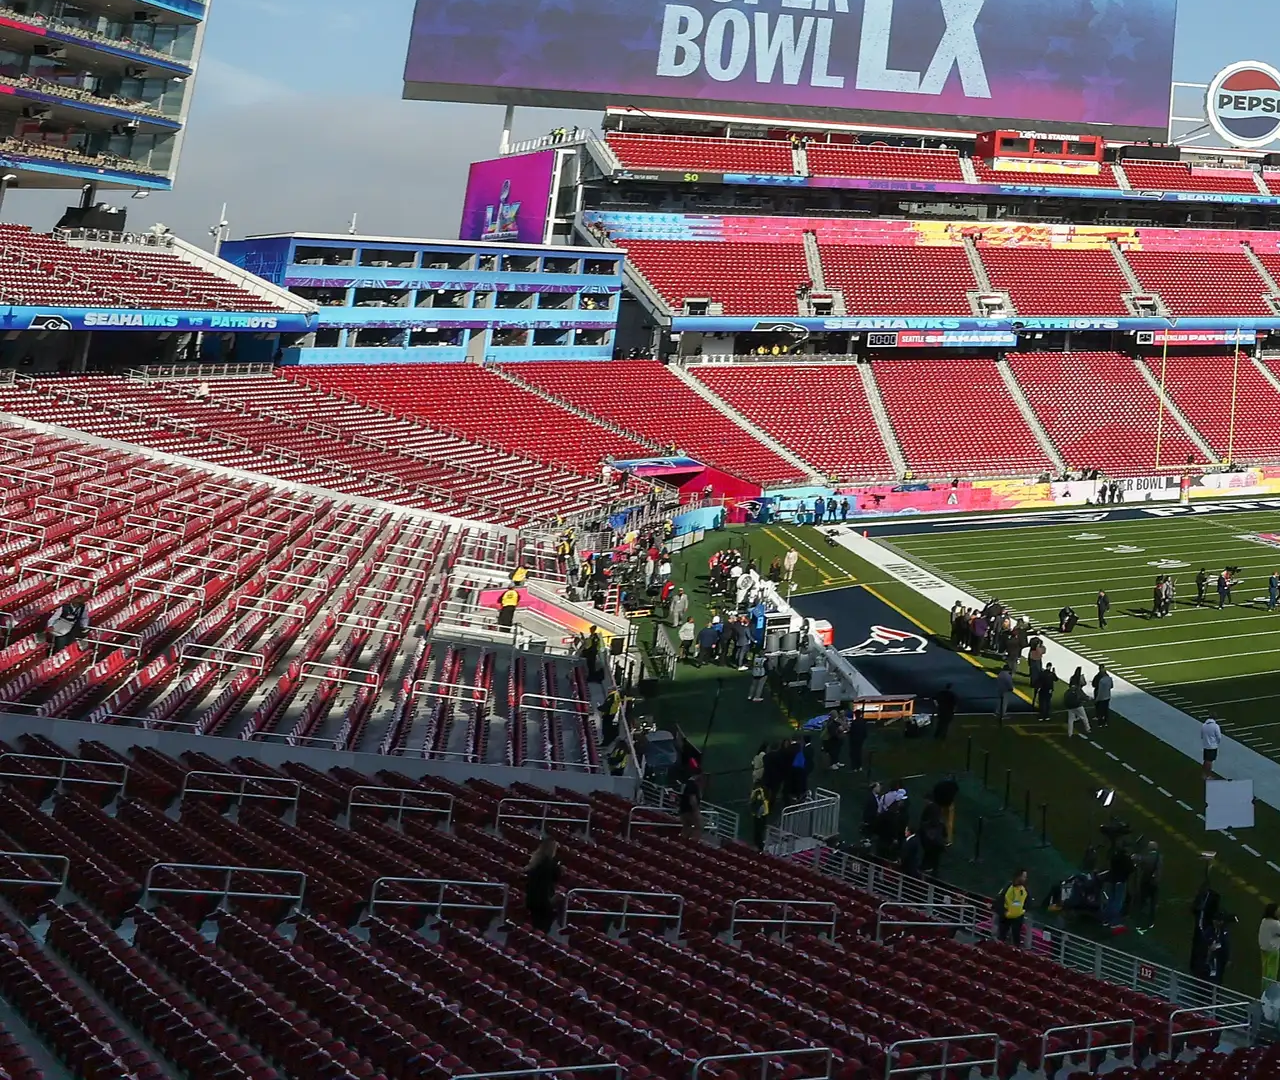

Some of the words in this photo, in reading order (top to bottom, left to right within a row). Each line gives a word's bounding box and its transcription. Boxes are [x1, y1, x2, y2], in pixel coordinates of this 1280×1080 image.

[656, 4, 845, 89] BOWL
[1047, 133, 1080, 142] STADIUM
[1176, 193, 1252, 203] SEAHAWKS
[84, 312, 179, 327] SEAHAWKS
[189, 317, 204, 326] VS
[210, 315, 278, 328] PATRIOTS
[823, 319, 960, 329] SEAHAWKS
[976, 320, 999, 328] VS
[902, 334, 925, 343] SEATTLE
[925, 334, 1014, 344] SEAHAWKS
[1188, 334, 1255, 342] PATRIOTS
[1136, 477, 1165, 491] BOWL
